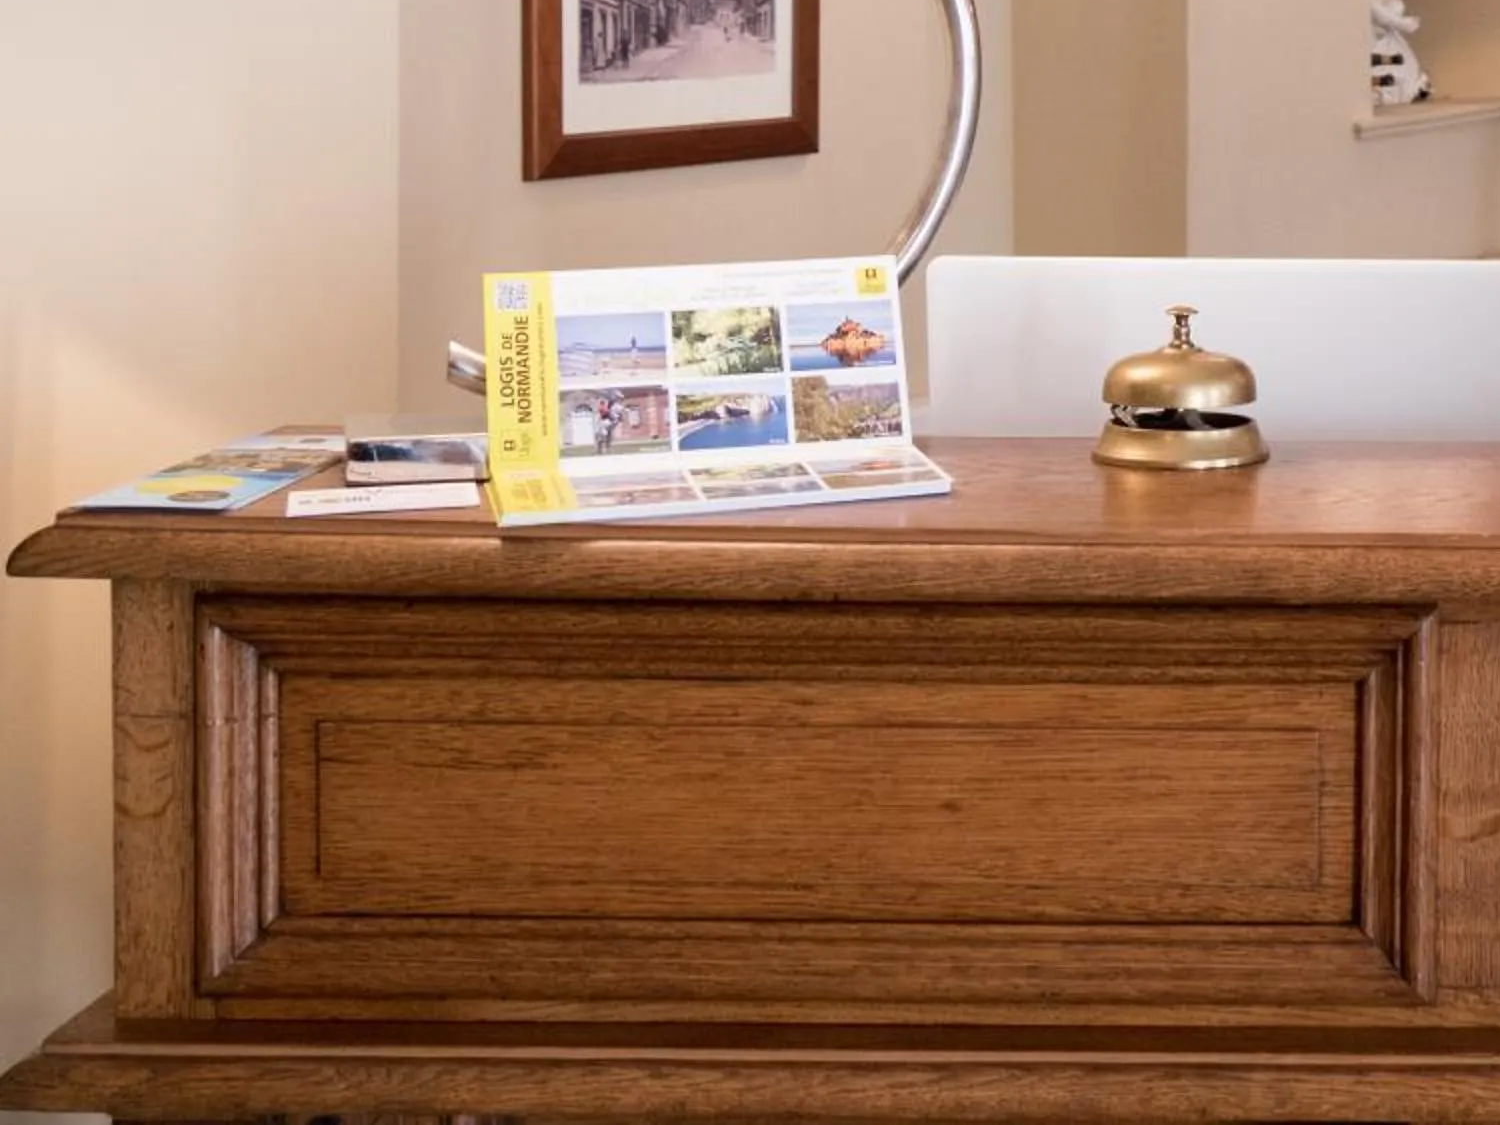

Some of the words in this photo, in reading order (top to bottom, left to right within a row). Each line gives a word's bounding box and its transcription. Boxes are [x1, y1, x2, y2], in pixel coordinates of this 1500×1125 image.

[502, 332, 513, 350] DE
[500, 356, 514, 407] LOGIS
[514, 316, 532, 423] NORMANDIE
